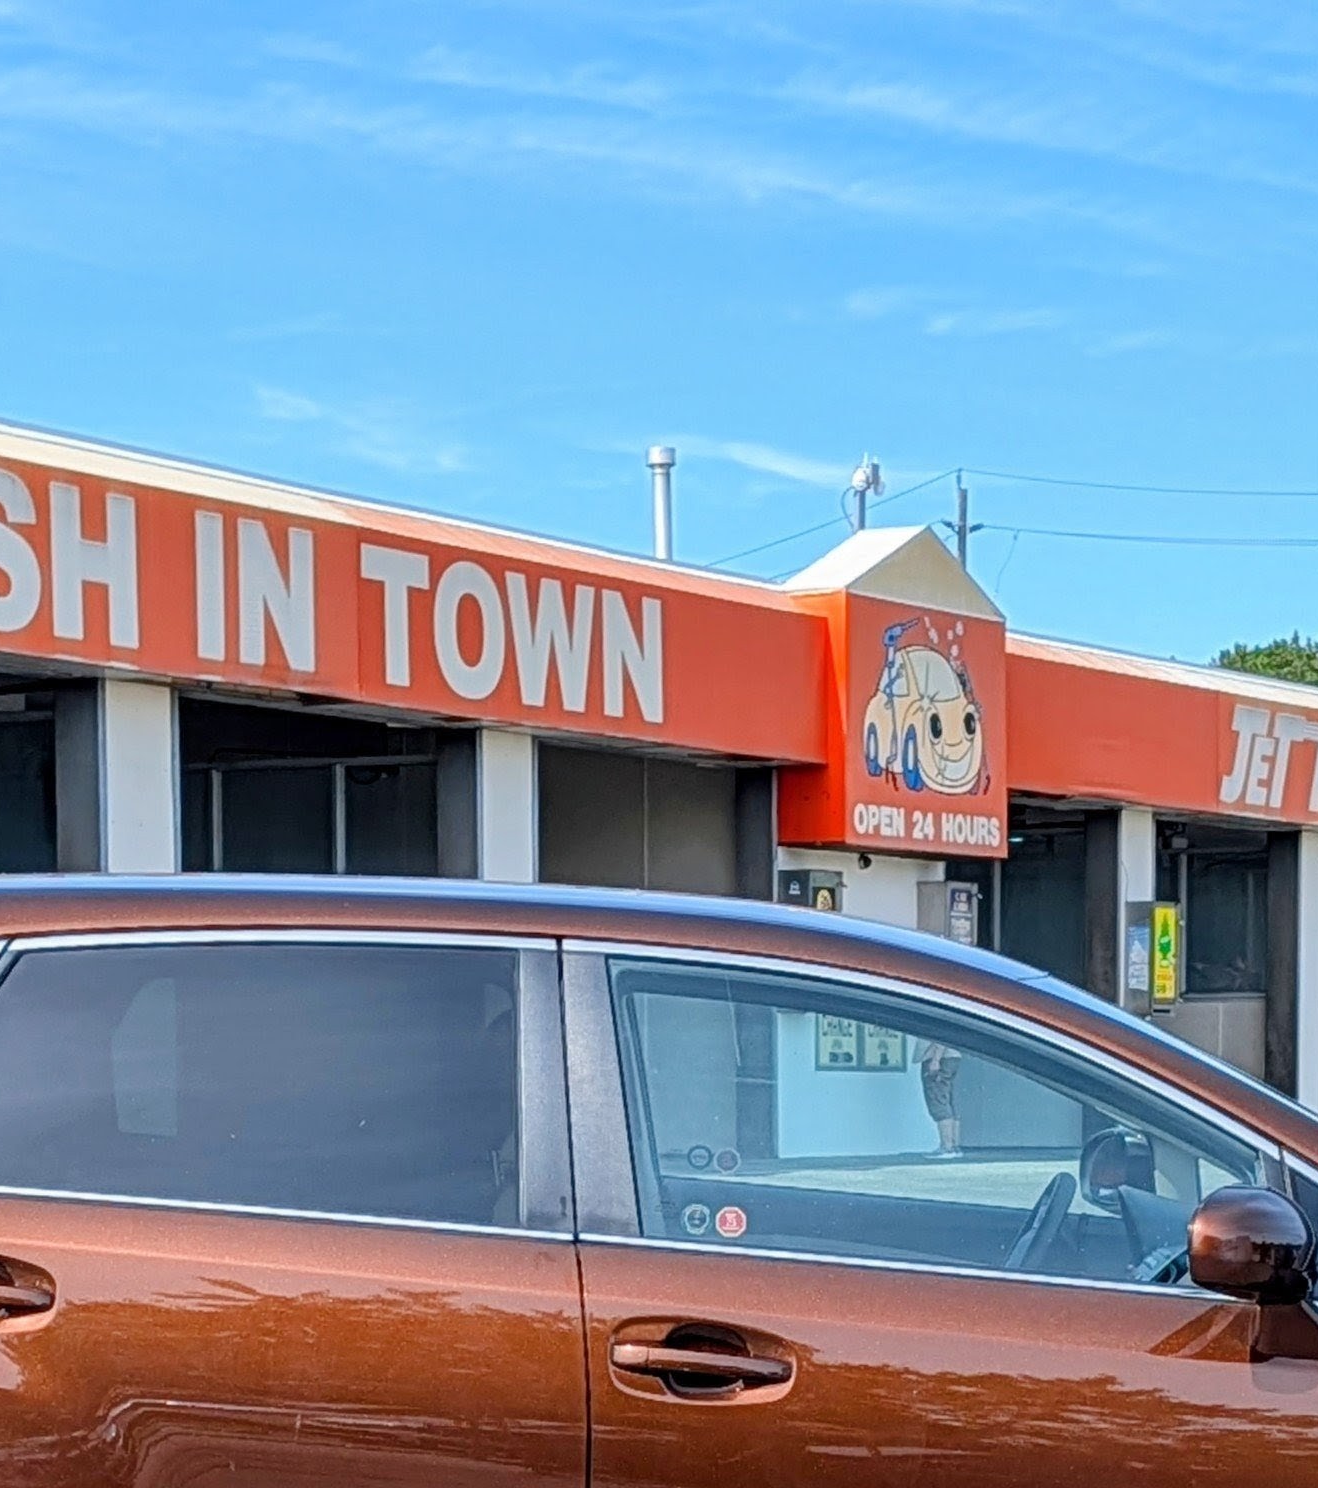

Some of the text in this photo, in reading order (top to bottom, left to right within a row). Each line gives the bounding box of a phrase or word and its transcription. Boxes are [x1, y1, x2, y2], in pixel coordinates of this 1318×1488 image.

[193, 509, 317, 673] IN
[360, 541, 664, 724] TOWN
[1219, 703, 1307, 809] JET
[853, 802, 1001, 848] OPEN 24 HOURS
